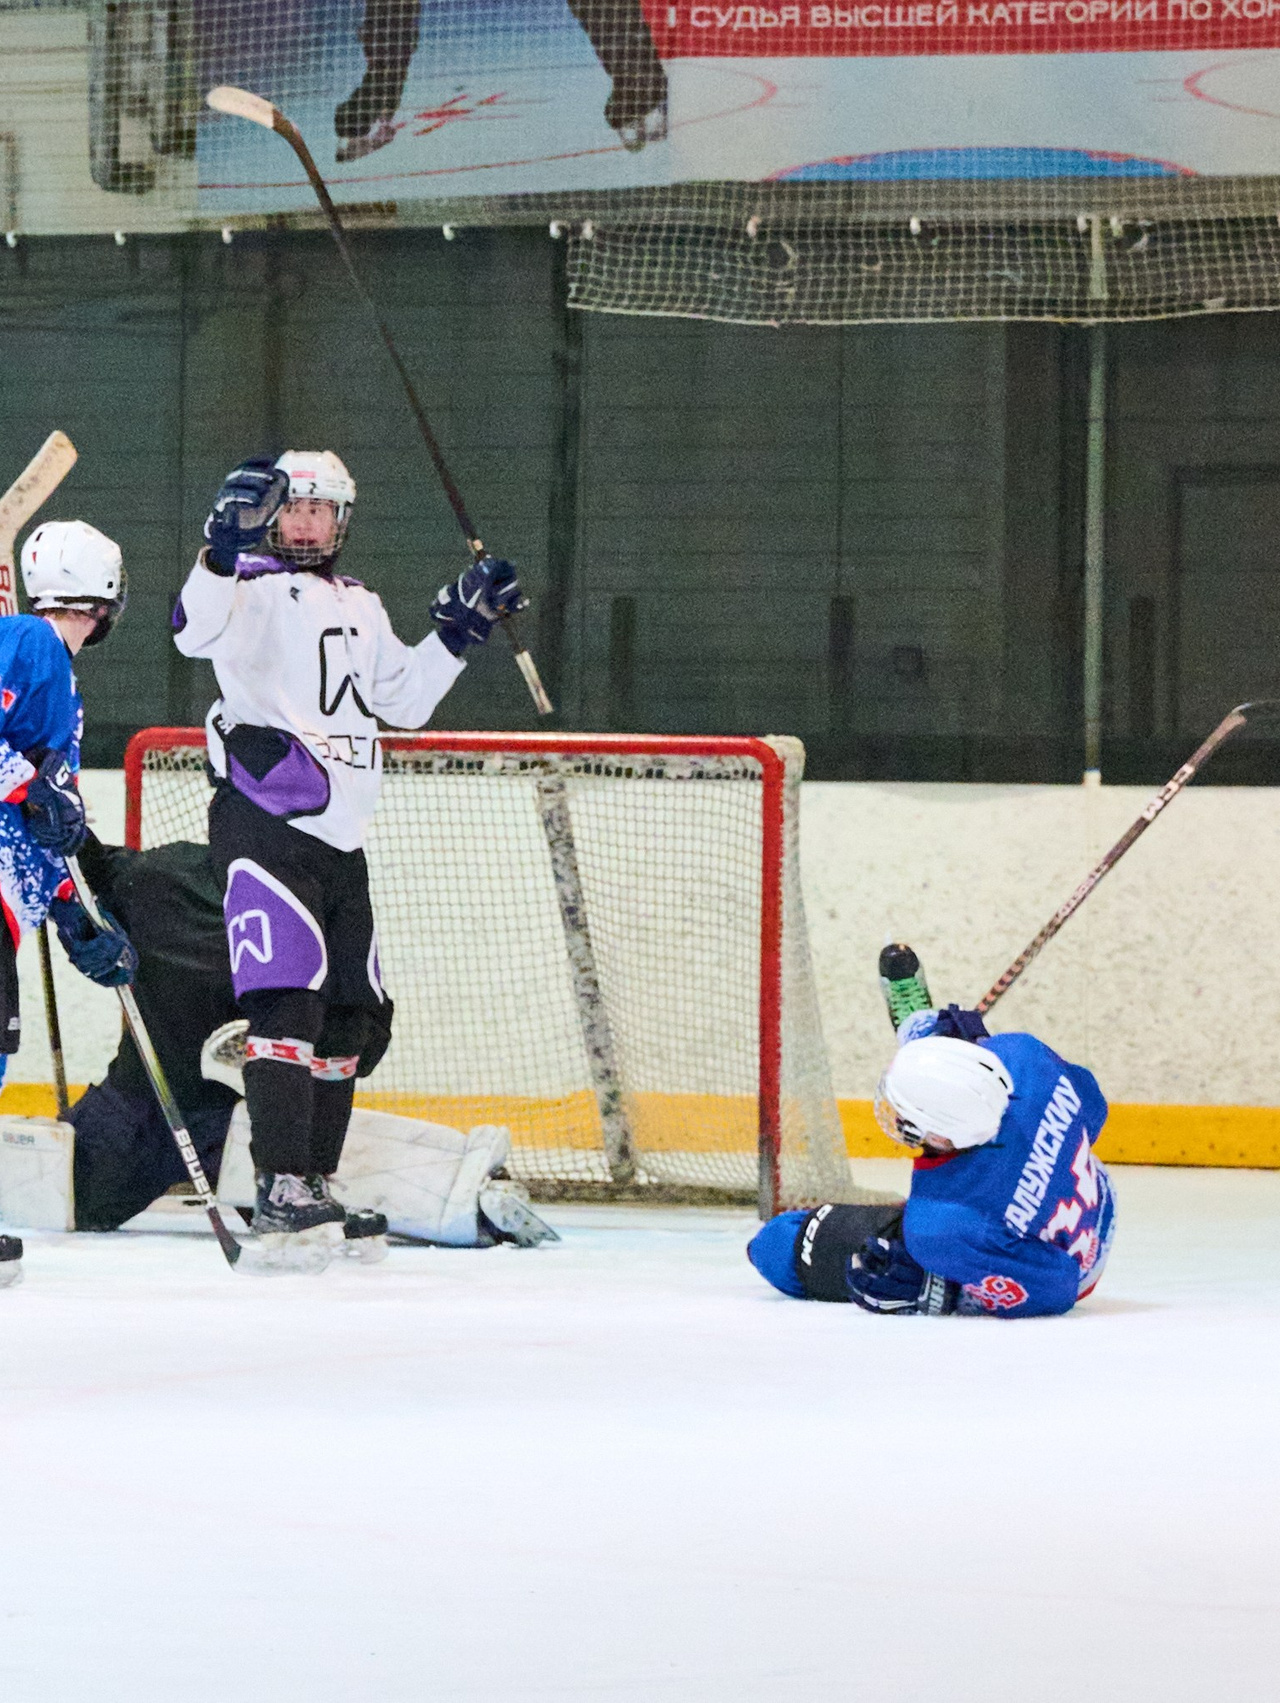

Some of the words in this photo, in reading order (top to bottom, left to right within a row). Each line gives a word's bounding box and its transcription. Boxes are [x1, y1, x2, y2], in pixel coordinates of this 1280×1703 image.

[690, 5, 801, 32] СУДЬЯ
[810, 0, 959, 28] ВЫСШЕЙ
[967, 1, 1158, 25] КАТЕГОРИИ
[1167, 0, 1212, 20] ПО
